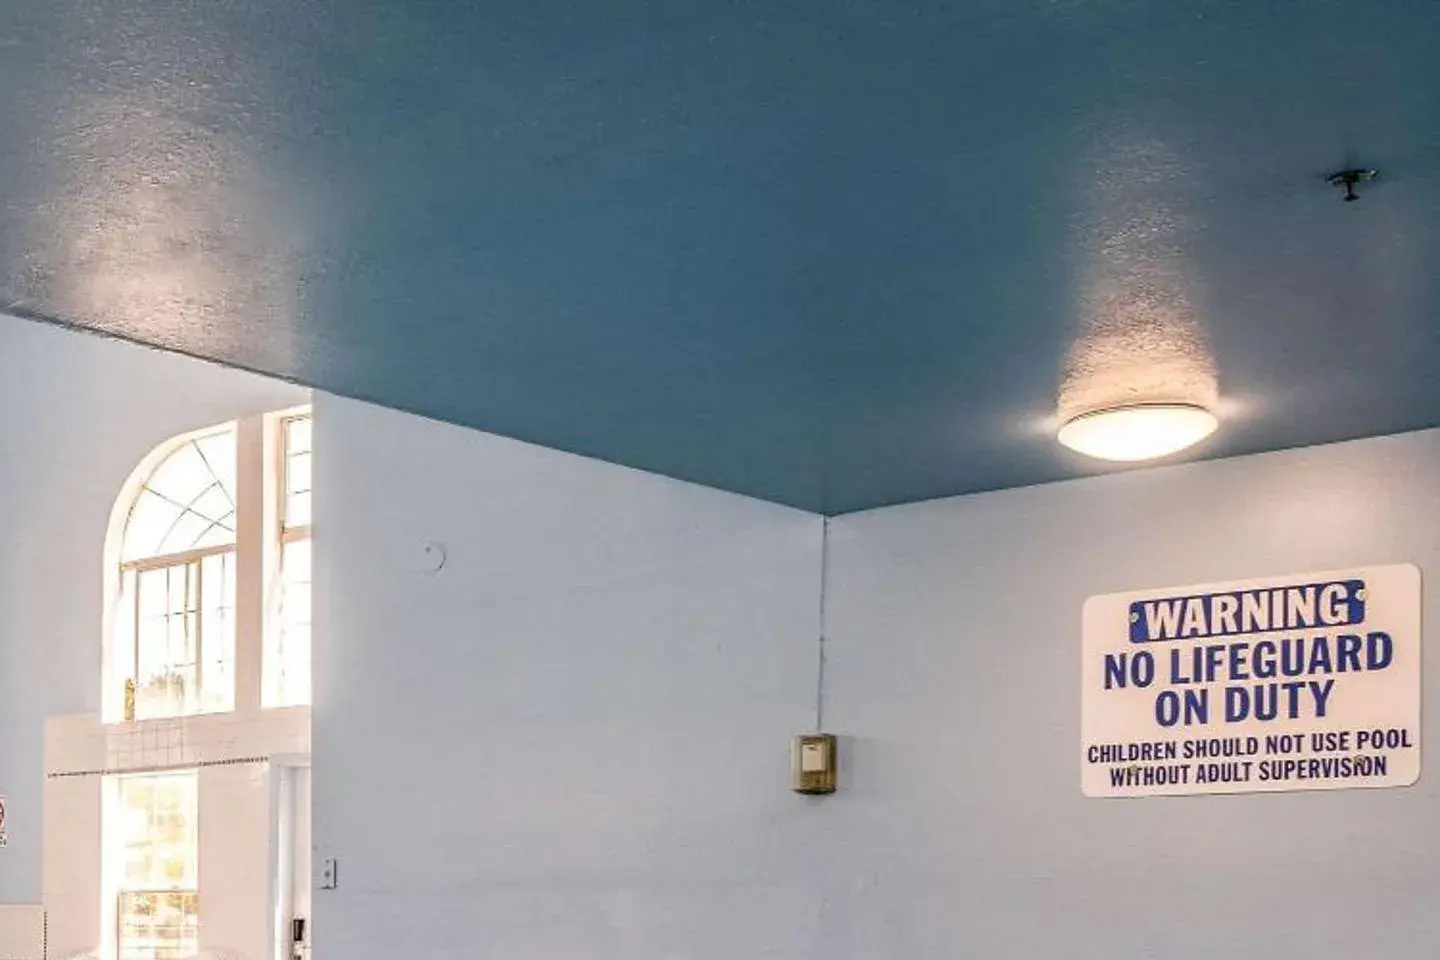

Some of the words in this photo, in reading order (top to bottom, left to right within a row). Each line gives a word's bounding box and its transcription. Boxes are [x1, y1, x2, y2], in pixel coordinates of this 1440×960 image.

[1144, 582, 1350, 643] WARNING
[1103, 651, 1155, 690] NO
[1169, 631, 1394, 686] LIFEGUARD
[1155, 688, 1209, 727] ON
[1224, 679, 1336, 723] DUTY
[1087, 739, 1177, 763] CHILDREN
[1182, 736, 1259, 759] SHOULD
[1265, 734, 1307, 755] NOT
[1311, 731, 1350, 752] USE
[1356, 728, 1413, 750] POOL
[1109, 764, 1190, 788] WITHOUT
[1195, 761, 1253, 785] ADULT
[1258, 755, 1388, 782] SUPERVISION
